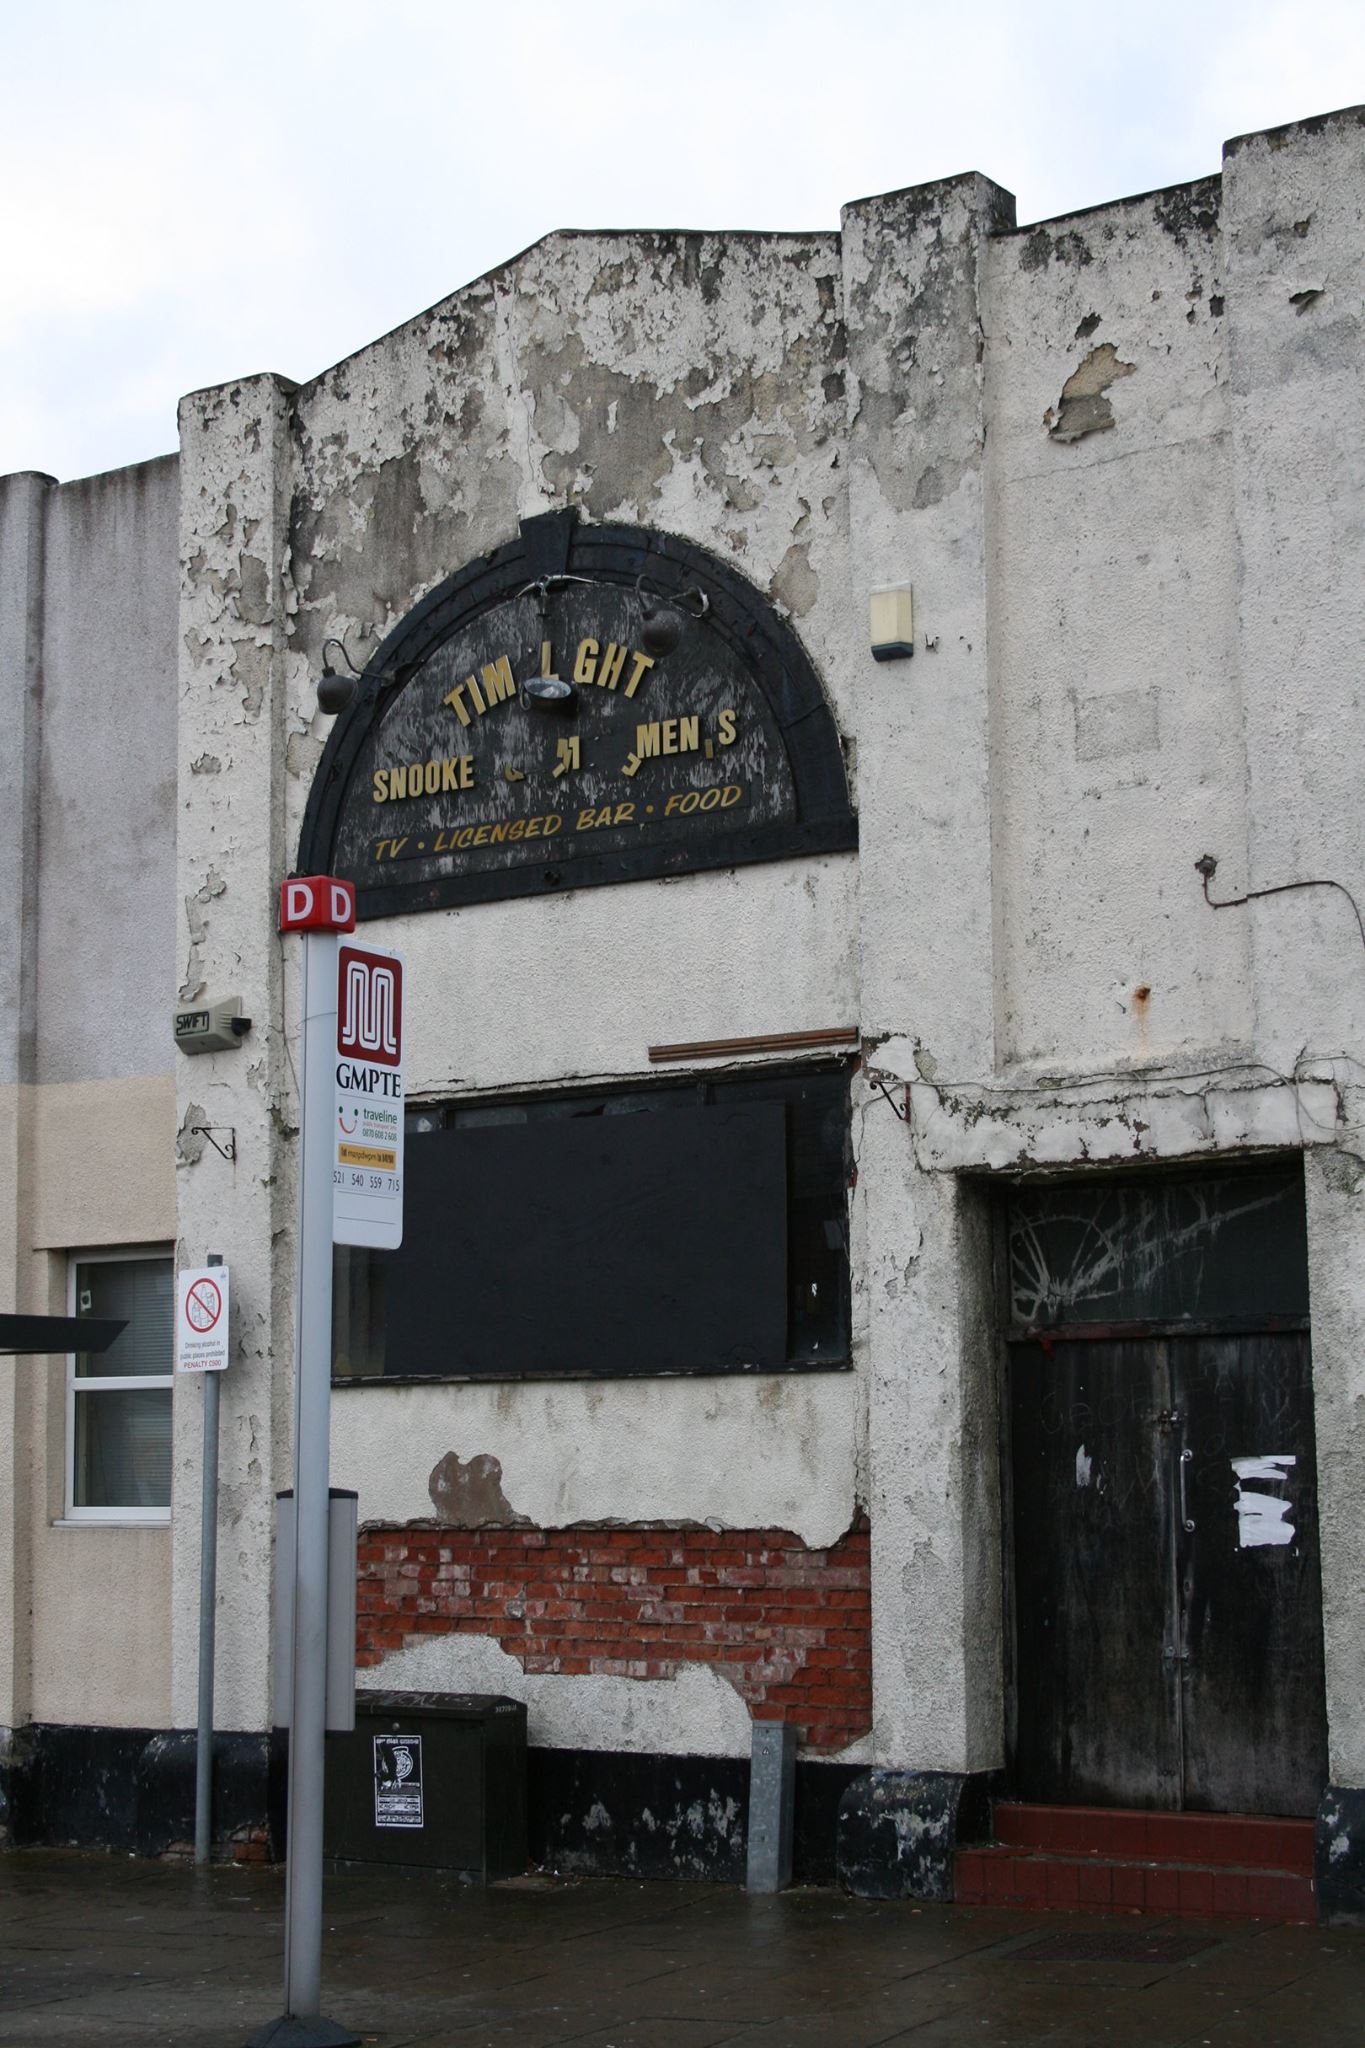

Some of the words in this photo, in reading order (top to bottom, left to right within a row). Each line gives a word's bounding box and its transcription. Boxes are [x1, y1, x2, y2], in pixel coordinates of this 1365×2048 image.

[372, 755, 475, 803] SNOOKE
[374, 837, 408, 861] TV
[432, 814, 562, 851] LICENSED
[575, 802, 636, 831] BAR
[664, 785, 742, 816] FOOD
[287, 883, 314, 922] D
[331, 885, 351, 924] D
[336, 1062, 402, 1098] GMPTE
[363, 1107, 398, 1125] traveline
[332, 1170, 345, 1184] 521
[351, 1173, 364, 1187] 540
[370, 1175, 382, 1189] 559
[388, 1178, 400, 1192] 715
